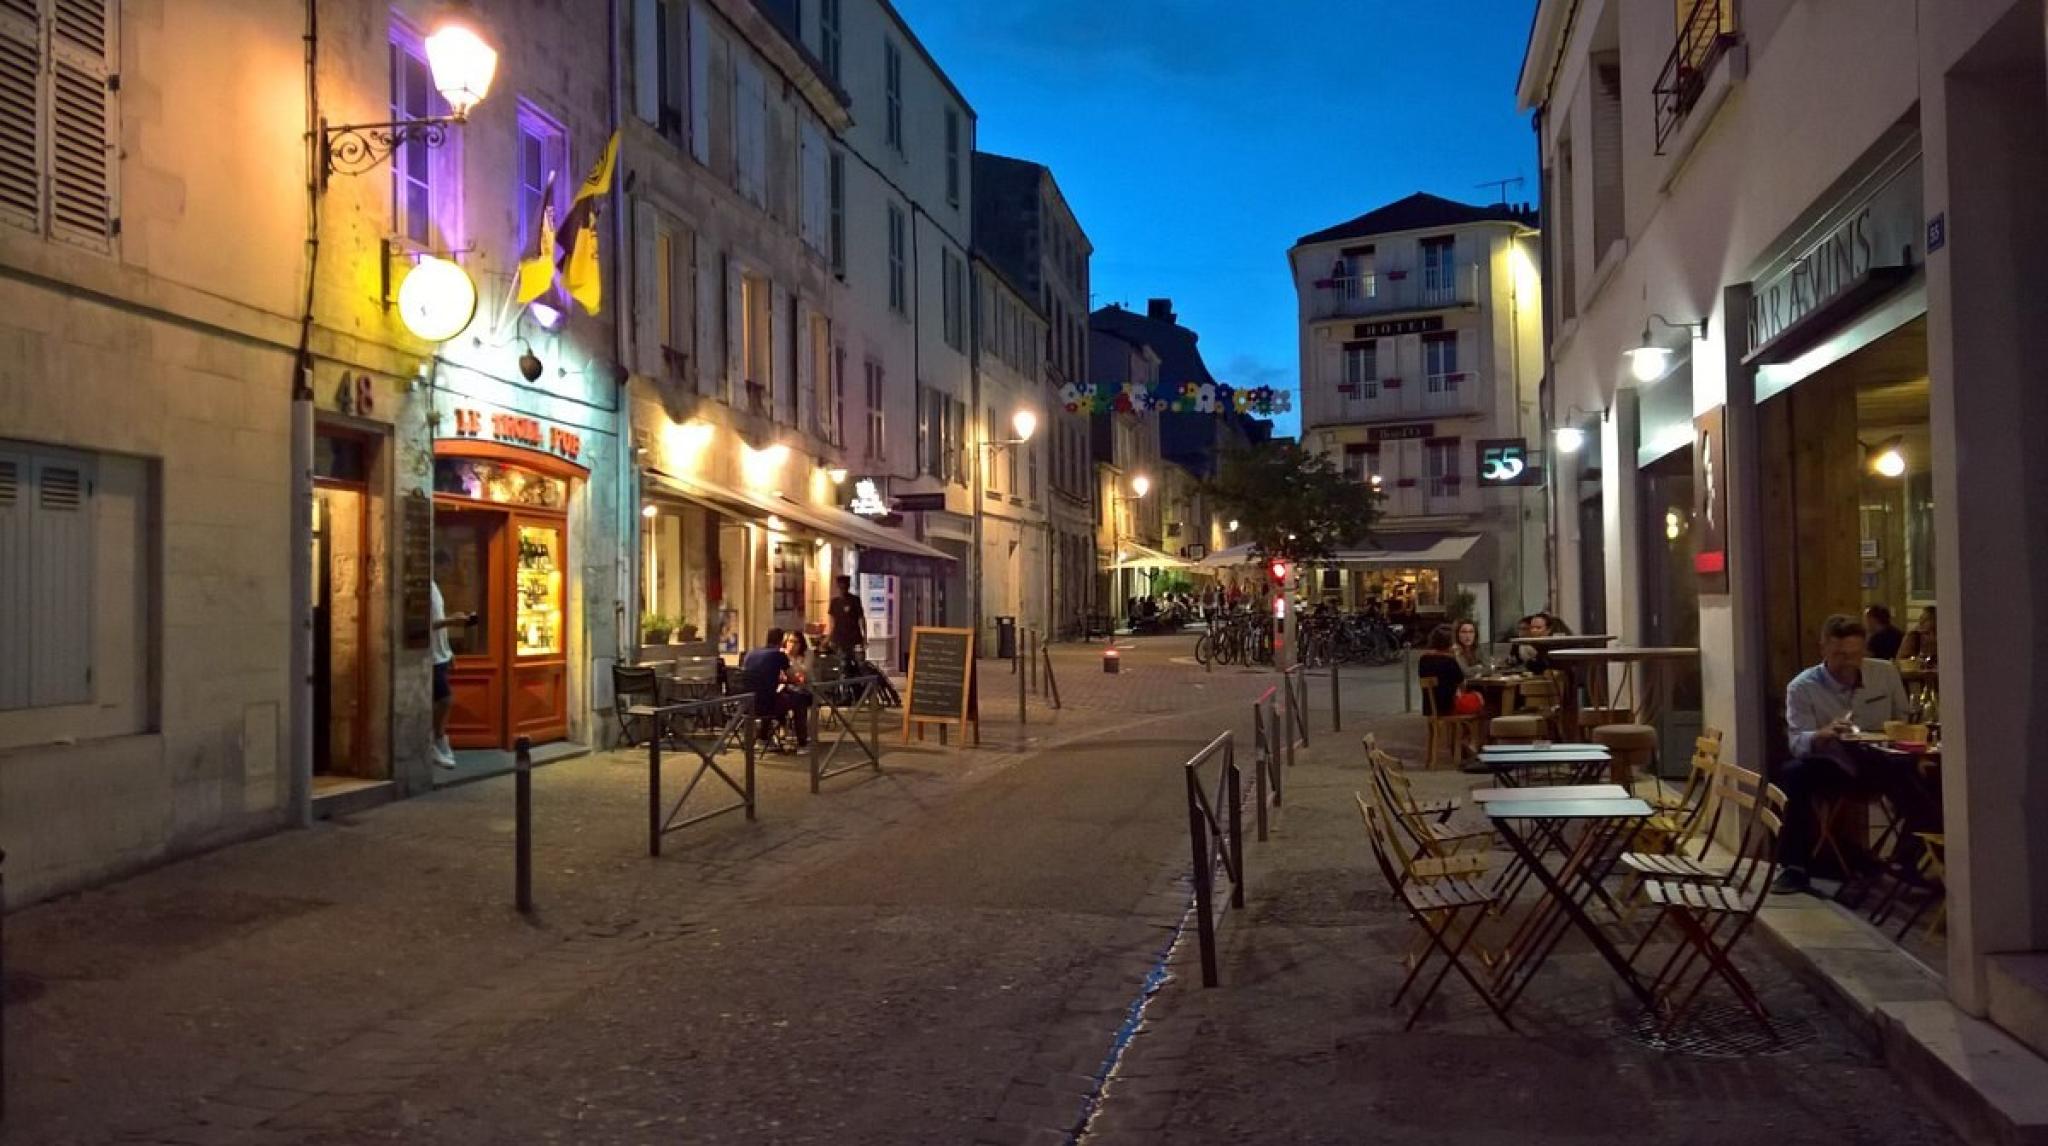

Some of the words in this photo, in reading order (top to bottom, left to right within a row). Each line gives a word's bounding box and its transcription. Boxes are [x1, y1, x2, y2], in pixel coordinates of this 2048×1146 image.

[1808, 207, 1870, 306] VINS
[334, 370, 373, 416] 48
[454, 408, 481, 436] LE
[550, 427, 580, 459] PUB
[1482, 447, 1523, 480] 55
